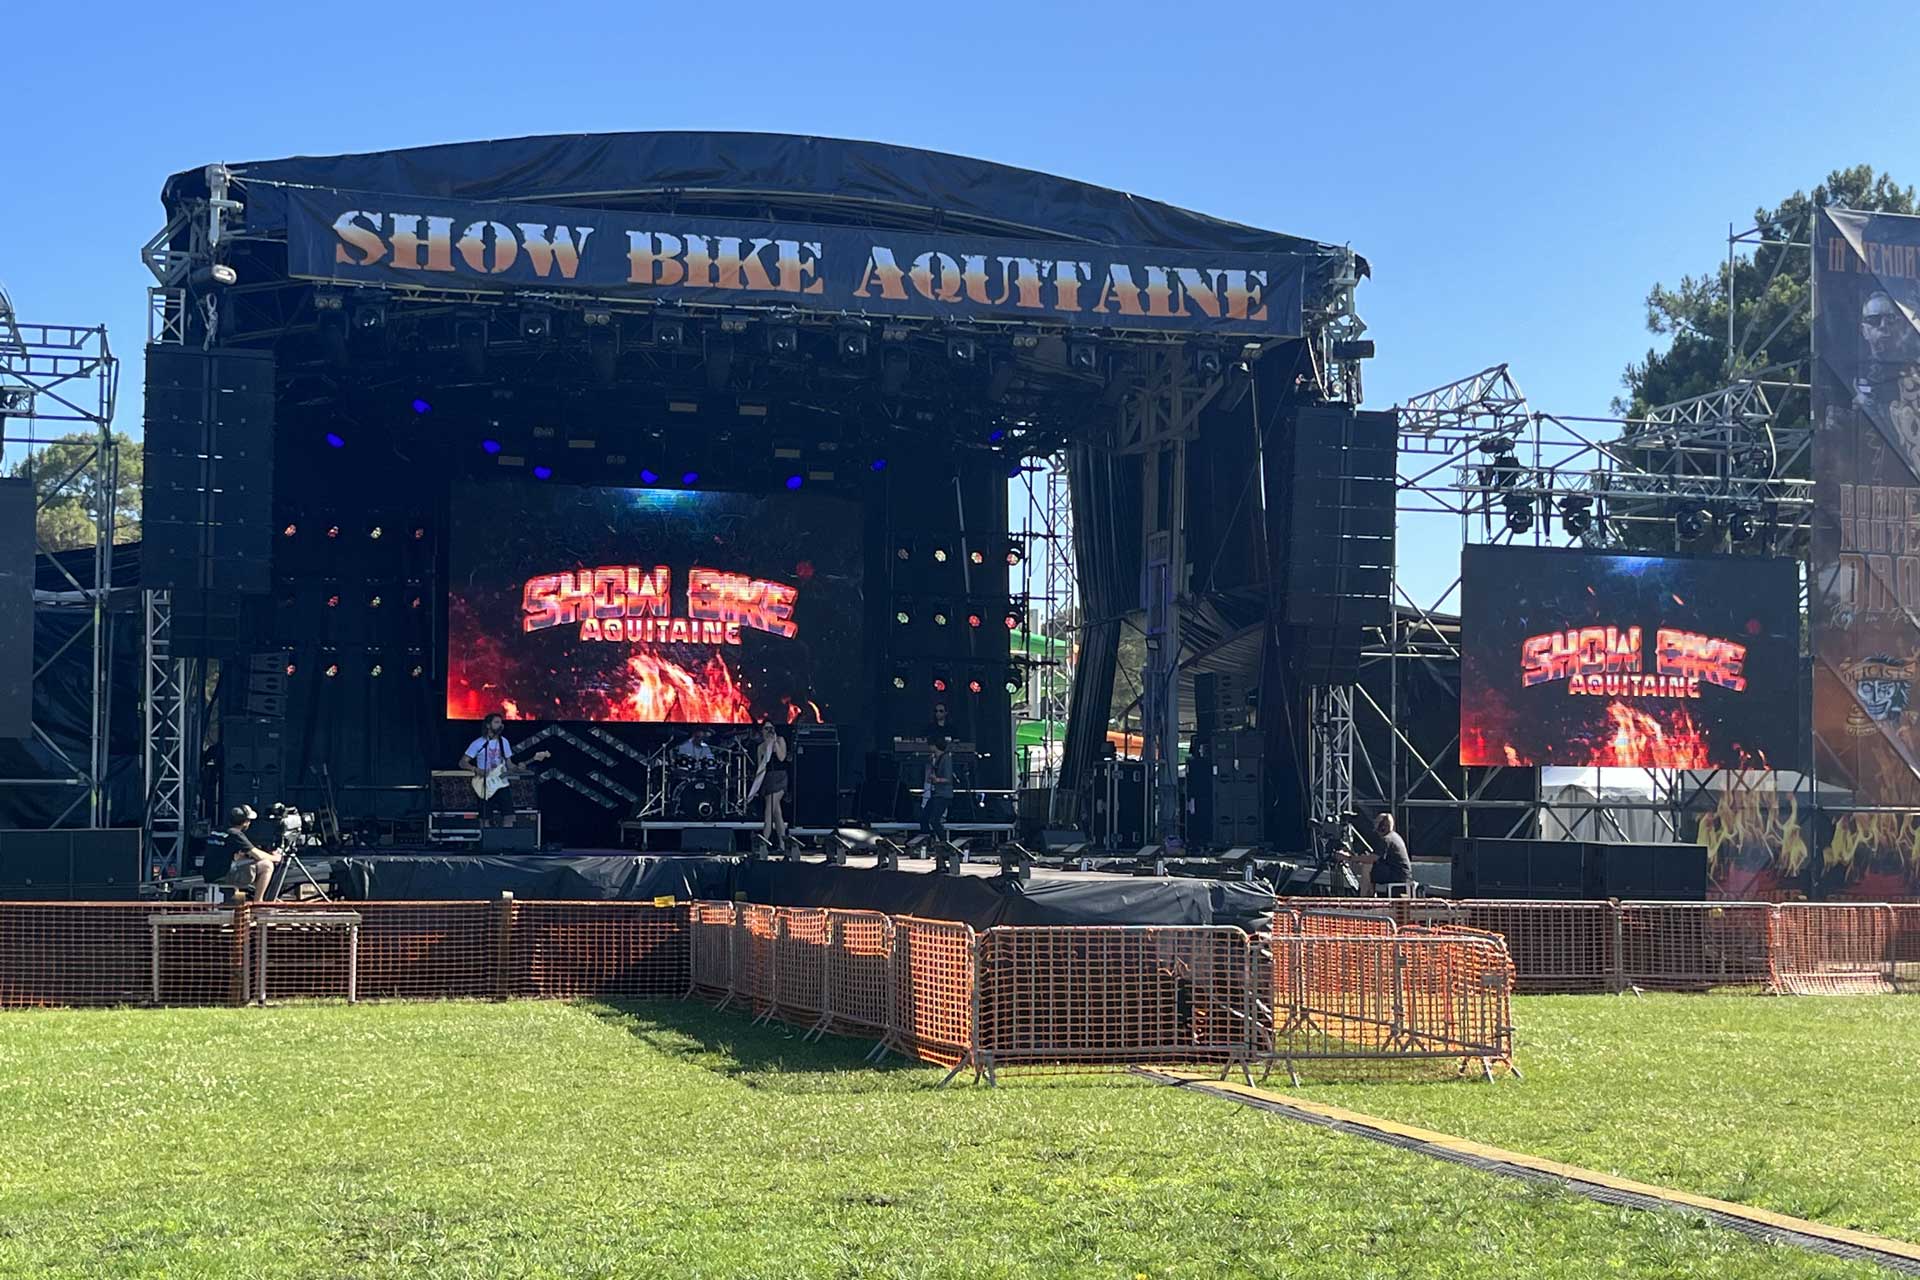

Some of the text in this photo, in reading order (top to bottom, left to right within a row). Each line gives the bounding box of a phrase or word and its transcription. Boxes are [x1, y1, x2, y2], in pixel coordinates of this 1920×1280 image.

[332, 209, 1268, 321] SHOW BIKE AQUITAINE
[522, 565, 798, 639] SHOW BIKE
[580, 617, 742, 645] AQUITAINE
[1520, 625, 1747, 692] SHOW BIKE
[1568, 674, 1700, 698] AQUITAINE
